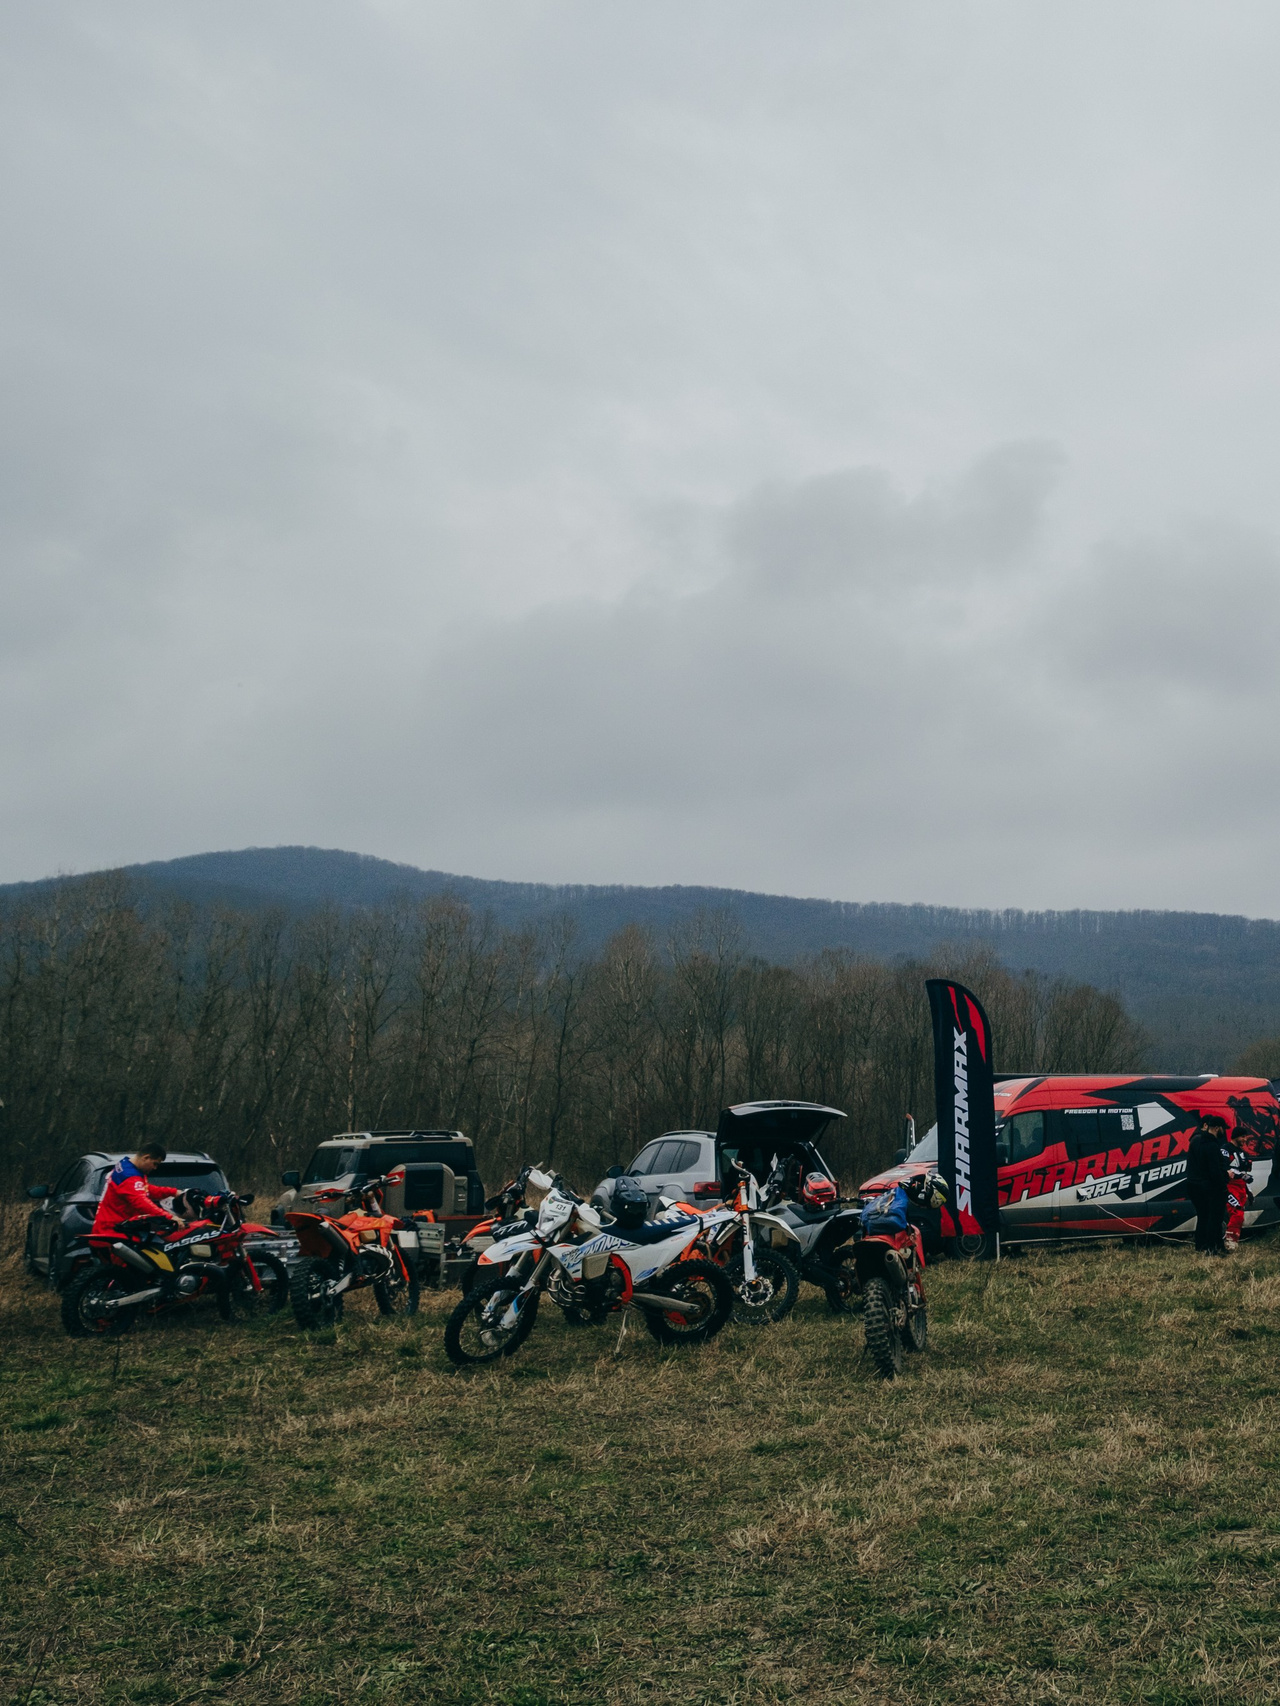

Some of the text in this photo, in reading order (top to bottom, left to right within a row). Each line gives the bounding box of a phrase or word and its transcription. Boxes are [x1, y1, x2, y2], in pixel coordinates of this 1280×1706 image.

[953, 1026, 973, 1217] SHARMAX
[1083, 1160, 1188, 1200] RACE TEAM
[555, 1203, 567, 1212] 131
[163, 1230, 222, 1253] GASGAS
